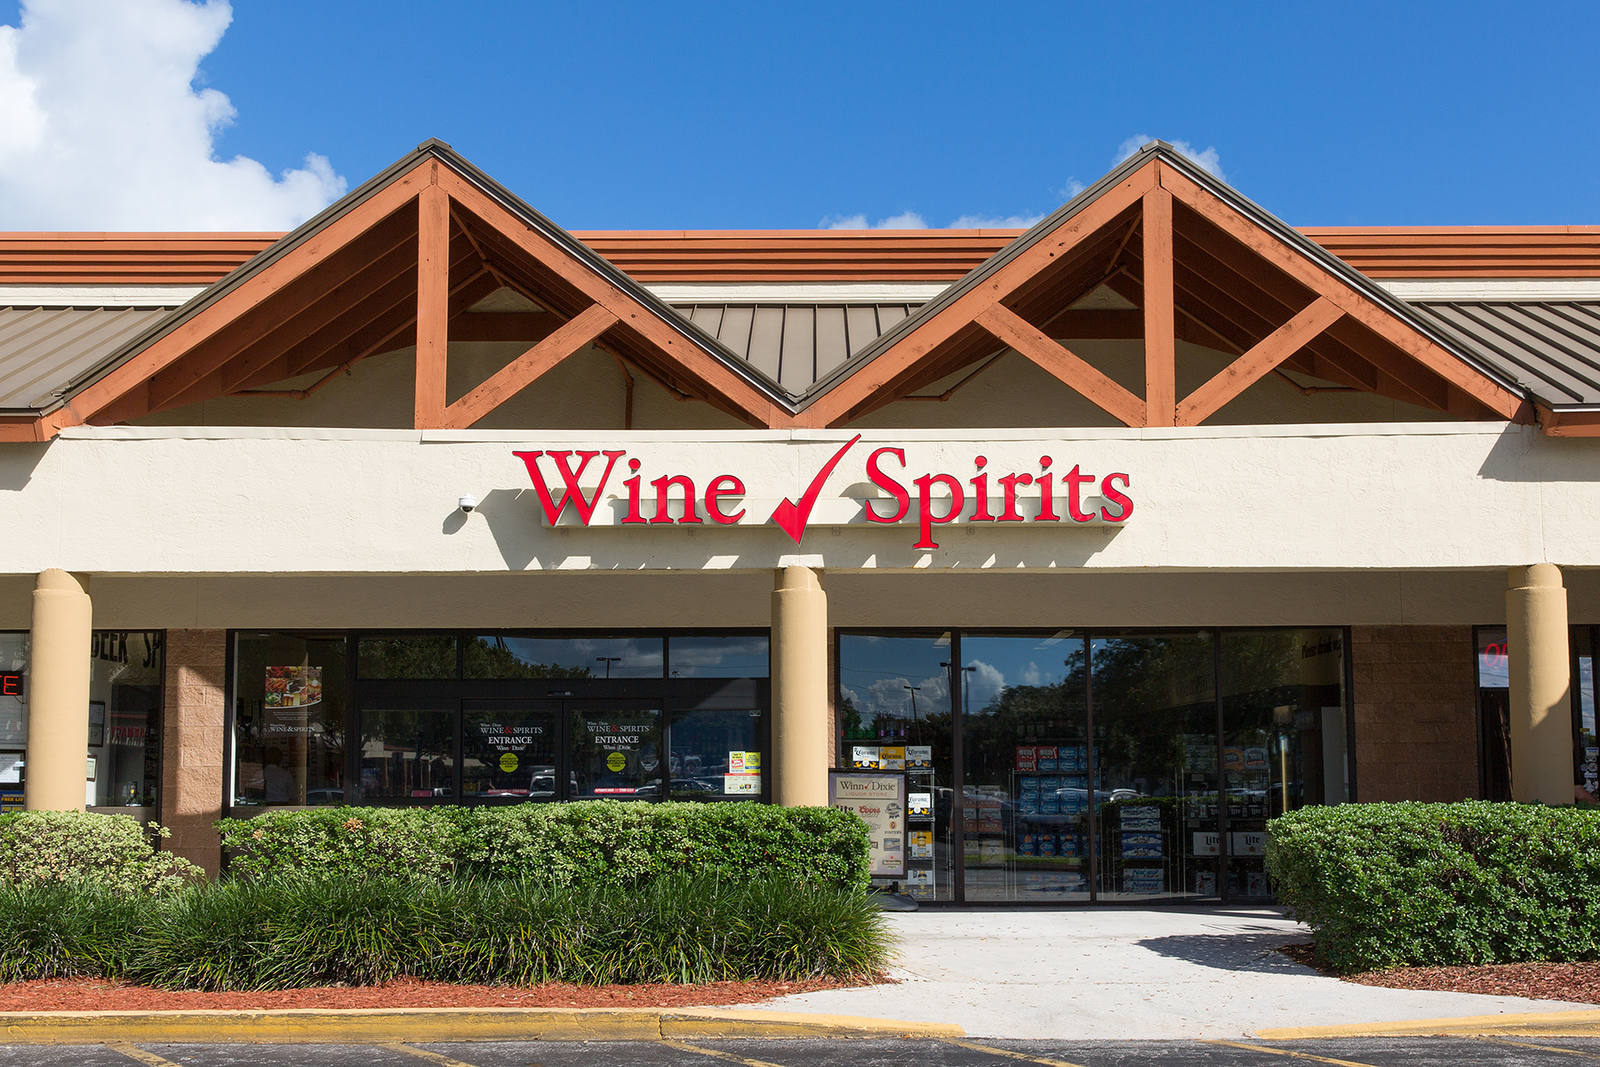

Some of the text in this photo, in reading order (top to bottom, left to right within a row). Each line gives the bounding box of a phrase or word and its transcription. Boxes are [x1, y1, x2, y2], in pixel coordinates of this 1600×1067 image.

[512, 447, 1134, 550] Wine Spirits
[0, 674, 19, 695] E
[488, 736, 532, 744] ENTRANCE
[595, 735, 639, 744] ENTRANCE
[840, 781, 896, 791] Winn Dixie
[859, 805, 881, 814] Coors
